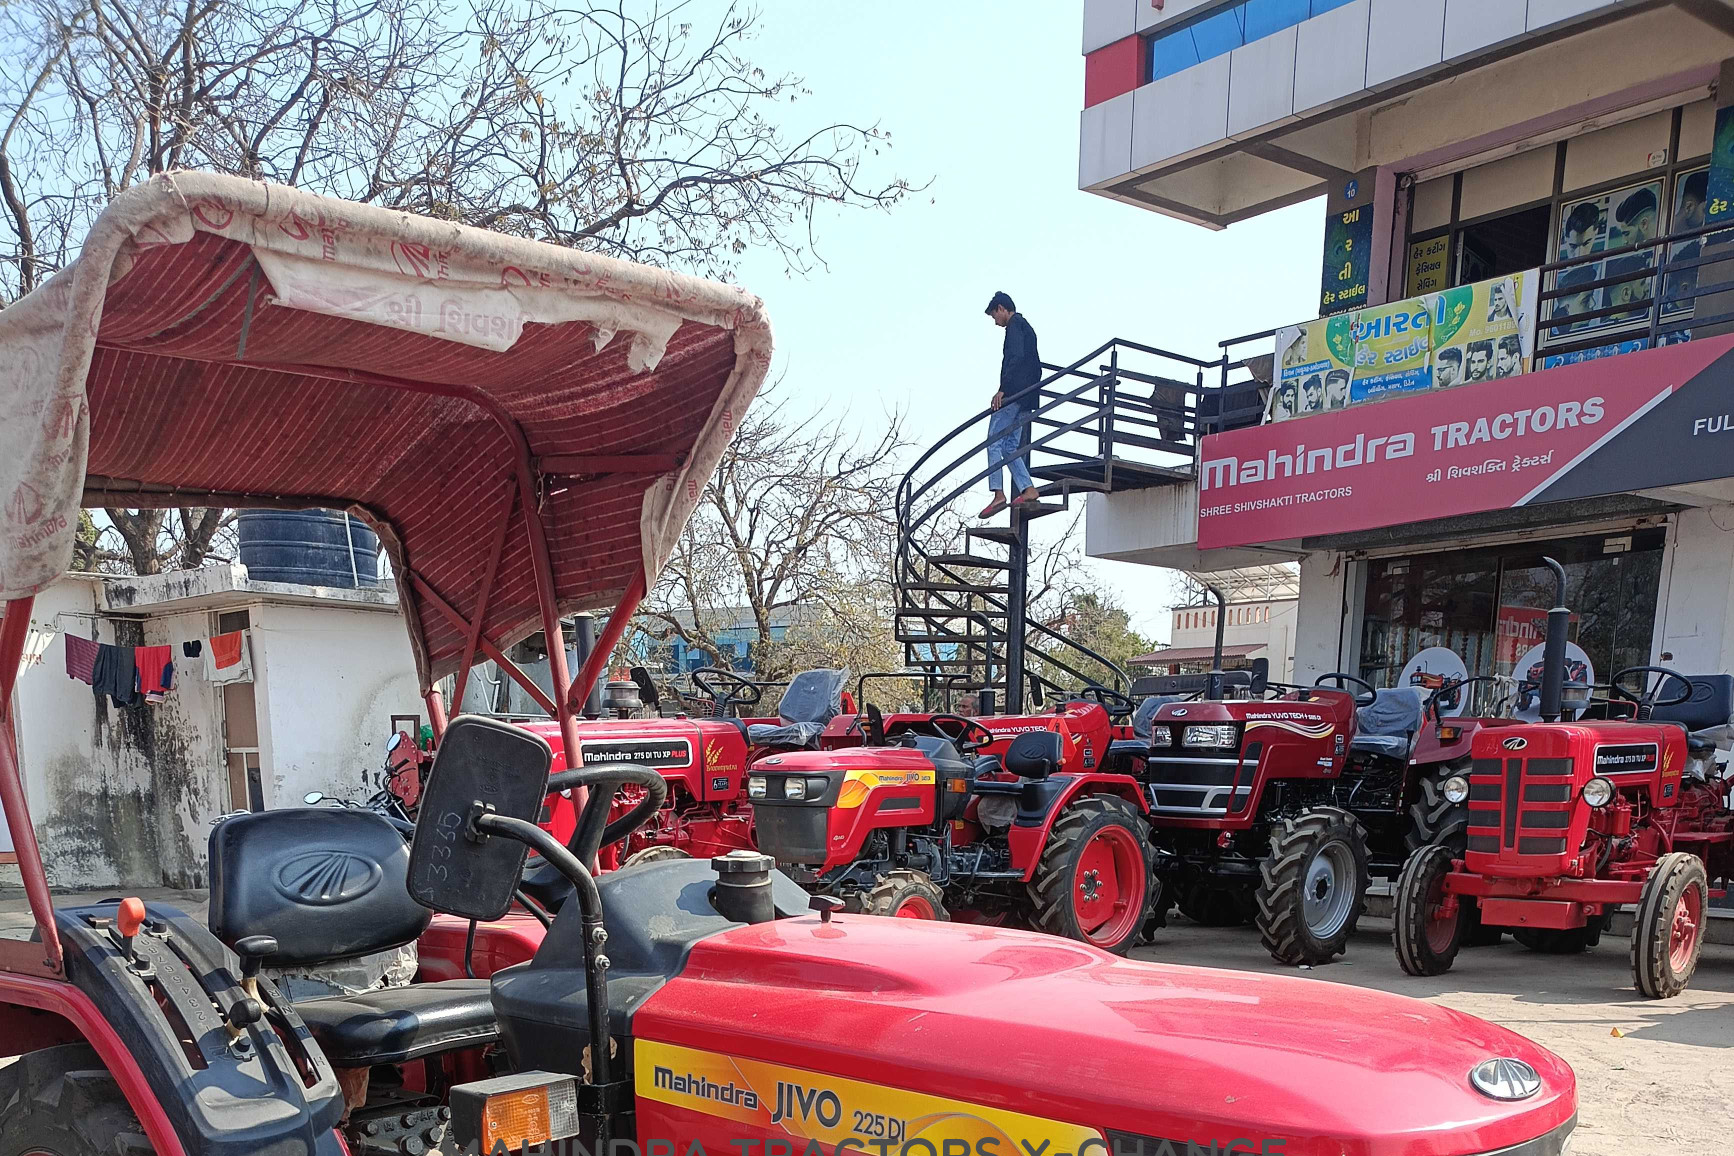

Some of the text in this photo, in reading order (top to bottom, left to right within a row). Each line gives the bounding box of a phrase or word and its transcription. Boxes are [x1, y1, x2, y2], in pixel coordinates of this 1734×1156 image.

[1347, 189, 1355, 198] 10
[1430, 396, 1606, 452] TRACTORS
[1200, 486, 1353, 518] SHREE SHIVSHAKTI TRACTORS
[633, 752, 645, 760] 275
[653, 751, 662, 759] TU
[671, 750, 687, 758] PLUS
[906, 772, 920, 782] JIVO
[770, 1079, 843, 1129] JIVO
